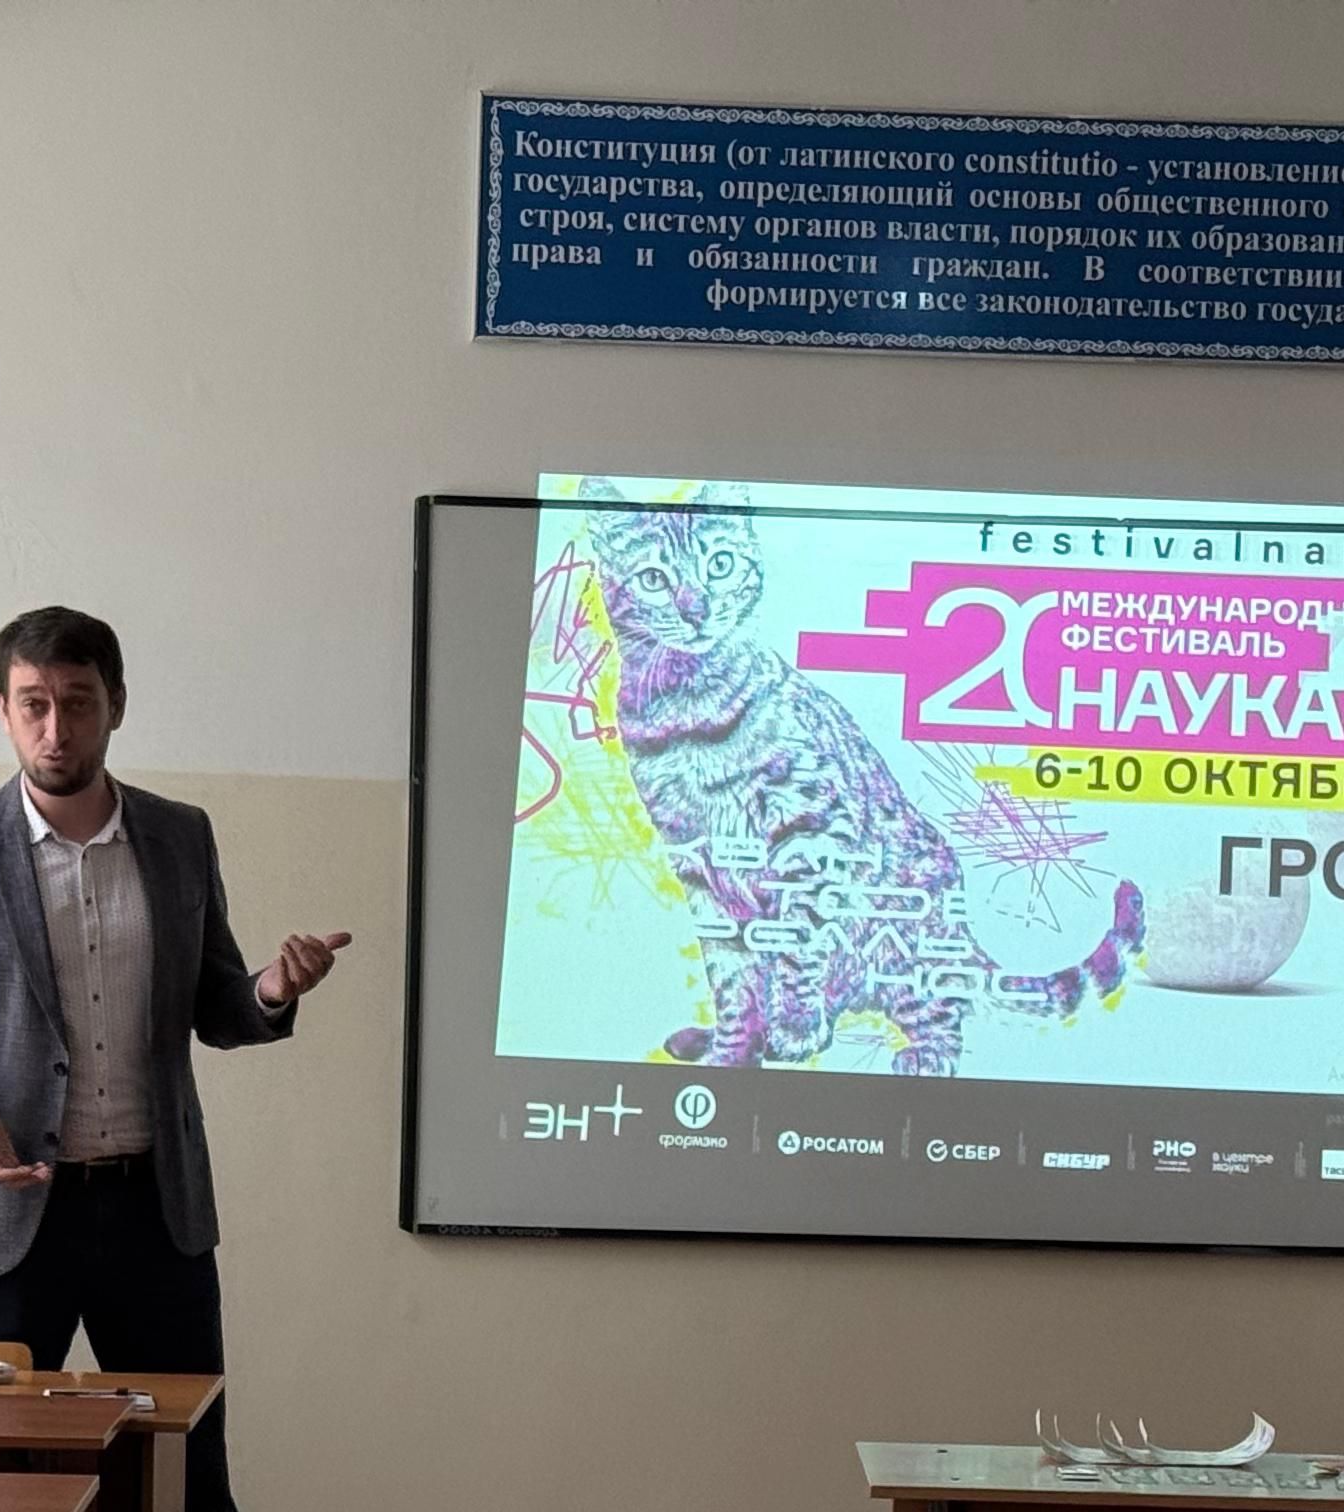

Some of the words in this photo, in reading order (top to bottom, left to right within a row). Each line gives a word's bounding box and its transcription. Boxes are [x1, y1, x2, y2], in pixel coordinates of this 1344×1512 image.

[514, 129, 717, 170] Конституция
[726, 138, 773, 171] (от
[778, 146, 956, 173] латинского
[963, 147, 1119, 178] constitutio
[512, 172, 705, 204] государства,
[718, 179, 954, 209] определяющий
[968, 187, 1082, 212] основы
[1096, 185, 1330, 219] общественного
[518, 207, 615, 237] строя,
[622, 211, 746, 243] систему
[753, 215, 878, 244] органов
[886, 220, 1001, 249] власти,
[1008, 223, 1139, 254] порядок
[1146, 228, 1182, 250] их
[510, 242, 603, 271] права
[635, 246, 655, 268] и
[687, 242, 879, 275] обязанности
[911, 255, 1051, 284] граждан.
[1082, 254, 1106, 282] В
[1137, 263, 1344, 290] соответствии
[705, 277, 909, 316] формируется
[917, 290, 968, 313] все
[974, 292, 1248, 322] законодательство
[1060, 622, 1287, 660] ФЕСТИВАЛЬ
[1057, 667, 1344, 744] НАУКА
[1032, 751, 1144, 794] 6-10
[802, 1135, 885, 1156] РОСАТОМ
[952, 1143, 1001, 1161] СБЕР
[1042, 1151, 1111, 1170] СИБУР
